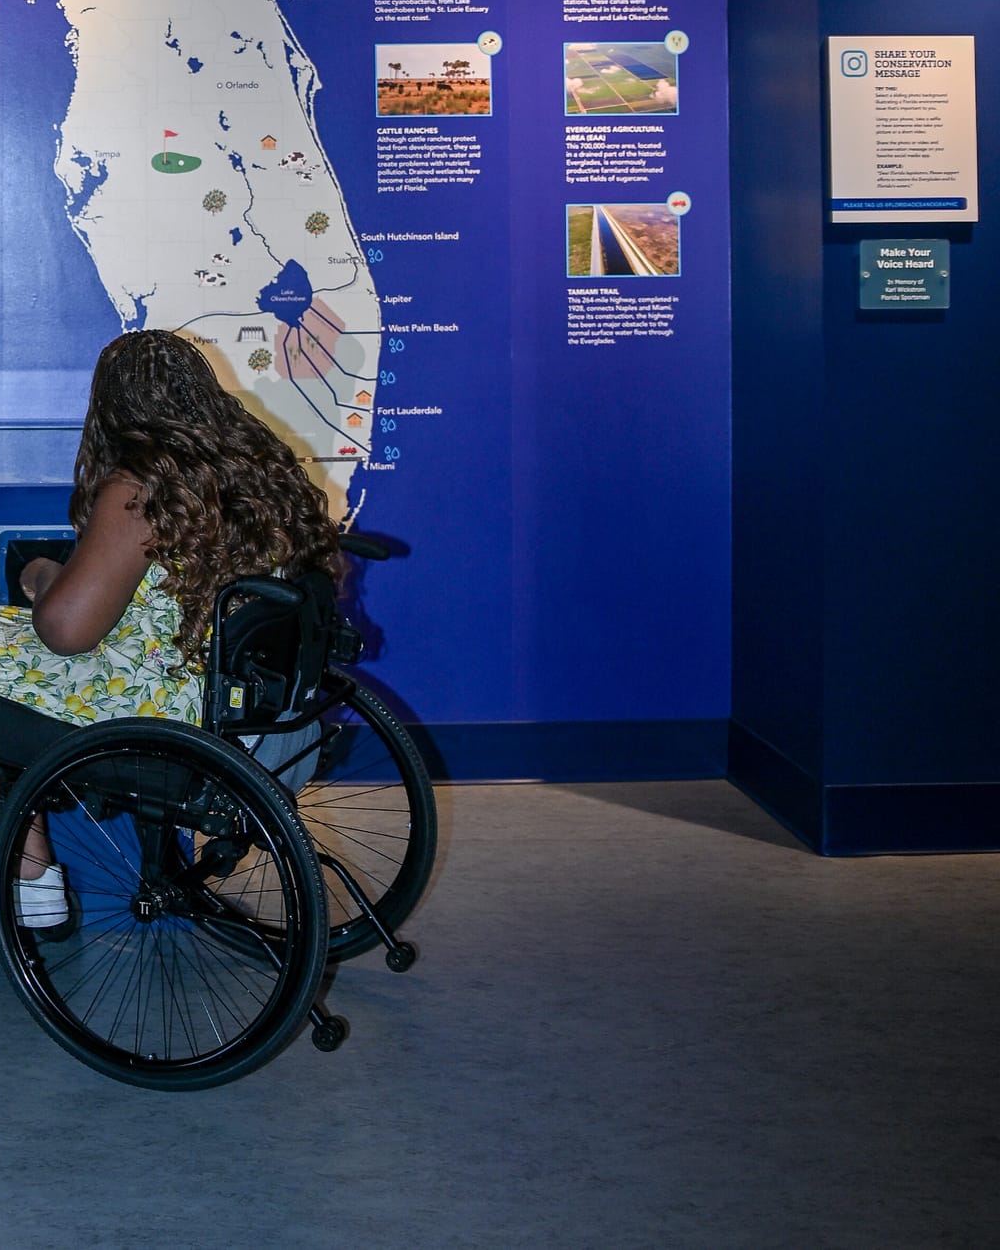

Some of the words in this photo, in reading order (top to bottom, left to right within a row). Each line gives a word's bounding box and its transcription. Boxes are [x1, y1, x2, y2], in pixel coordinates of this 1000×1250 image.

[875, 51, 907, 59] SHARE
[875, 60, 951, 68] CONSERVATION
[875, 70, 920, 78] MESSAGE
[95, 151, 120, 159] Tampa
[880, 249, 906, 257] Make
[877, 260, 903, 268] Voice
[905, 260, 934, 268] Heard
[383, 295, 412, 305] Jupiter
[193, 337, 218, 345] Myers
